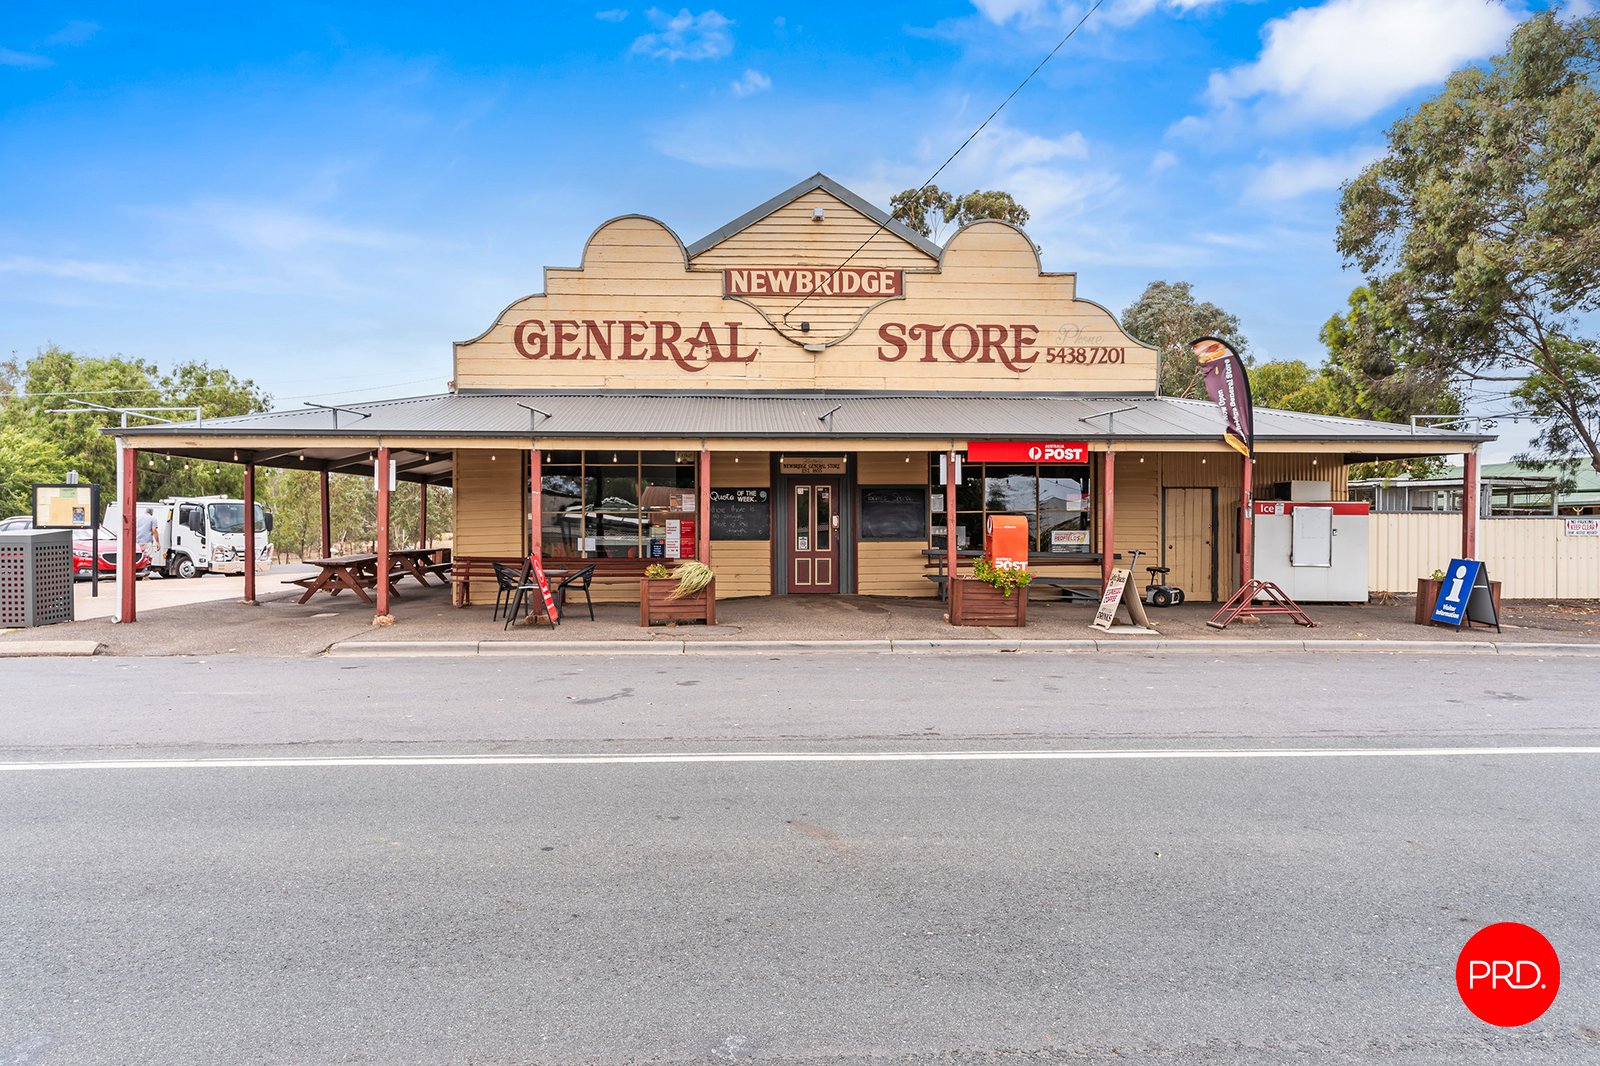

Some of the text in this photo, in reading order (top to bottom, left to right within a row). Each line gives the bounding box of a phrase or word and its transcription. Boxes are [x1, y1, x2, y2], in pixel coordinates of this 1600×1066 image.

[730, 270, 895, 295] NEWBRIDGE
[1055, 323, 1104, 345] Phone
[513, 319, 1041, 373] GENERAL STORE
[1046, 347, 1125, 364] 5438 7201
[1224, 358, 1234, 379] Store
[1217, 389, 1227, 407] Open
[1226, 379, 1237, 408] General
[1044, 448, 1083, 460] POST
[710, 491, 735, 502] Quote
[1260, 504, 1275, 513] Ice
[995, 560, 1029, 571] POST
[1435, 609, 1460, 619] Information
